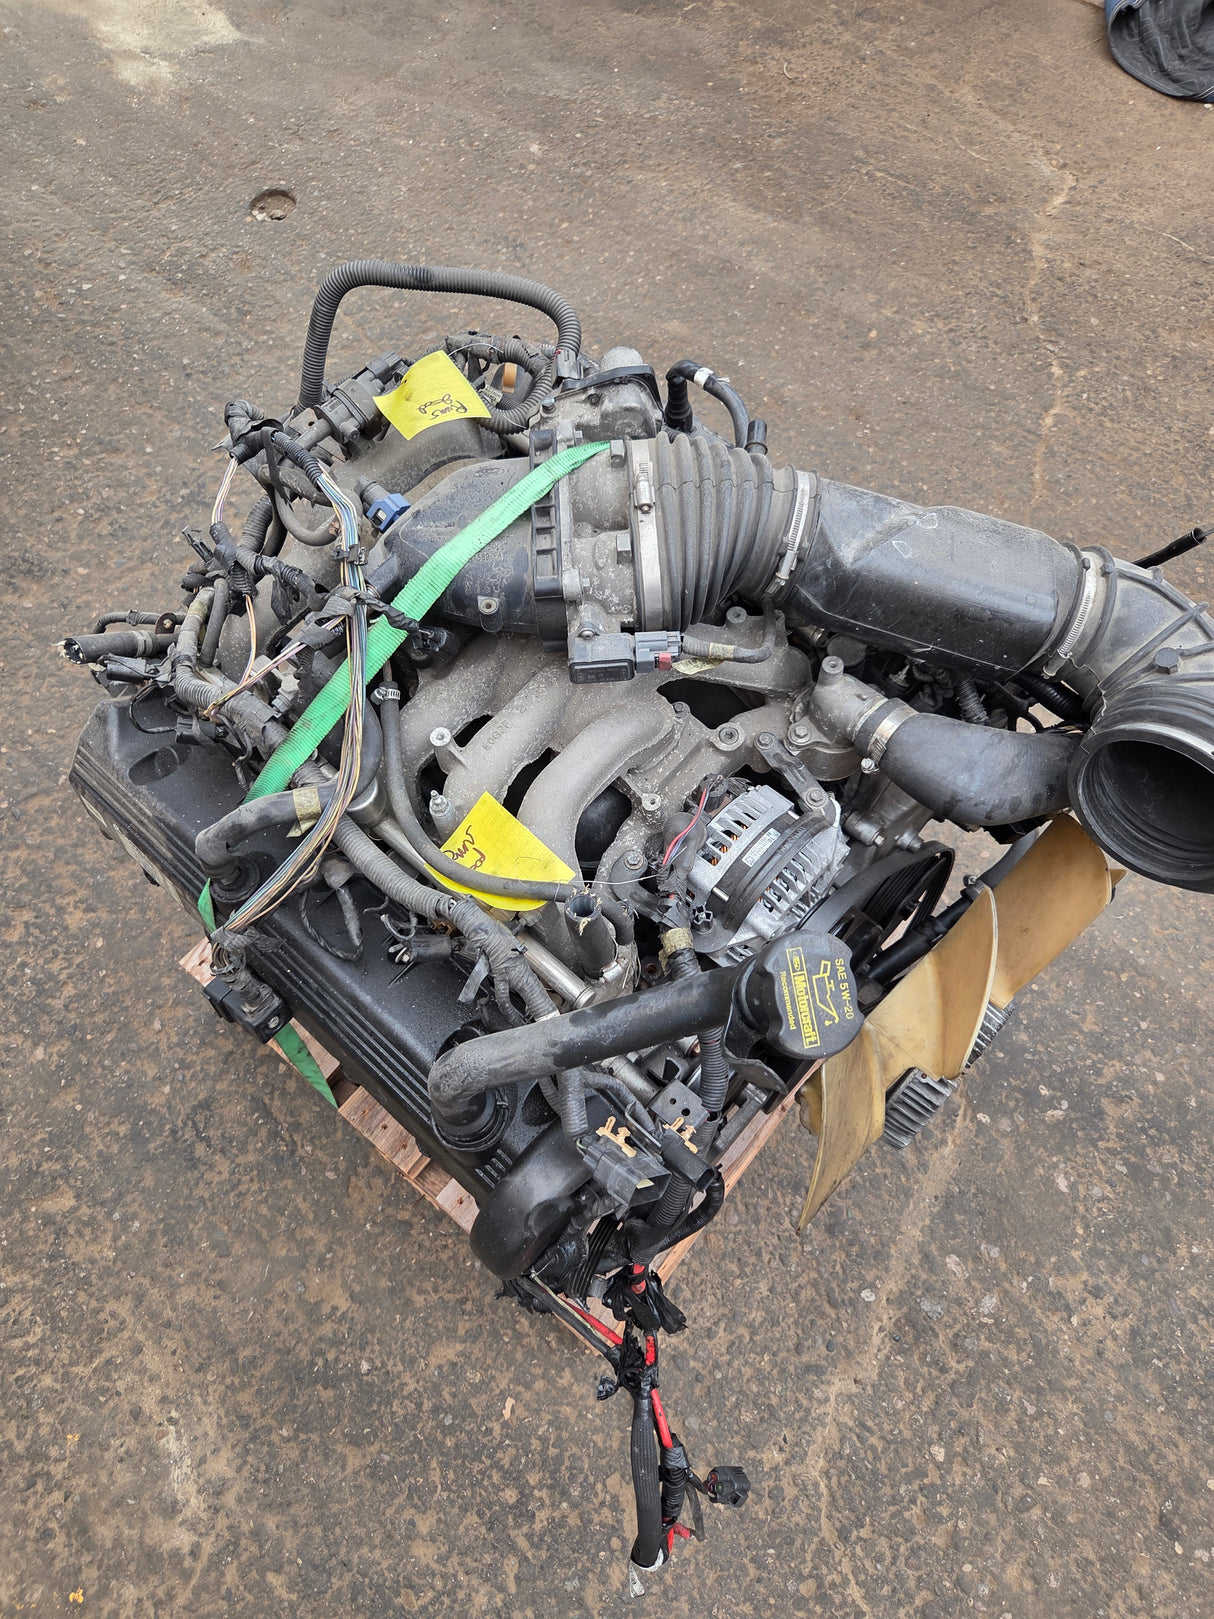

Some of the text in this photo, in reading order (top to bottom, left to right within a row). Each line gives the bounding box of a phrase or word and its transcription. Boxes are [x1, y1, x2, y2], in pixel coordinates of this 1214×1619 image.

[779, 971, 797, 1030] Recommended
[793, 974, 818, 1043] Motorcraft
[835, 958, 855, 1020] SAE 5W-20
